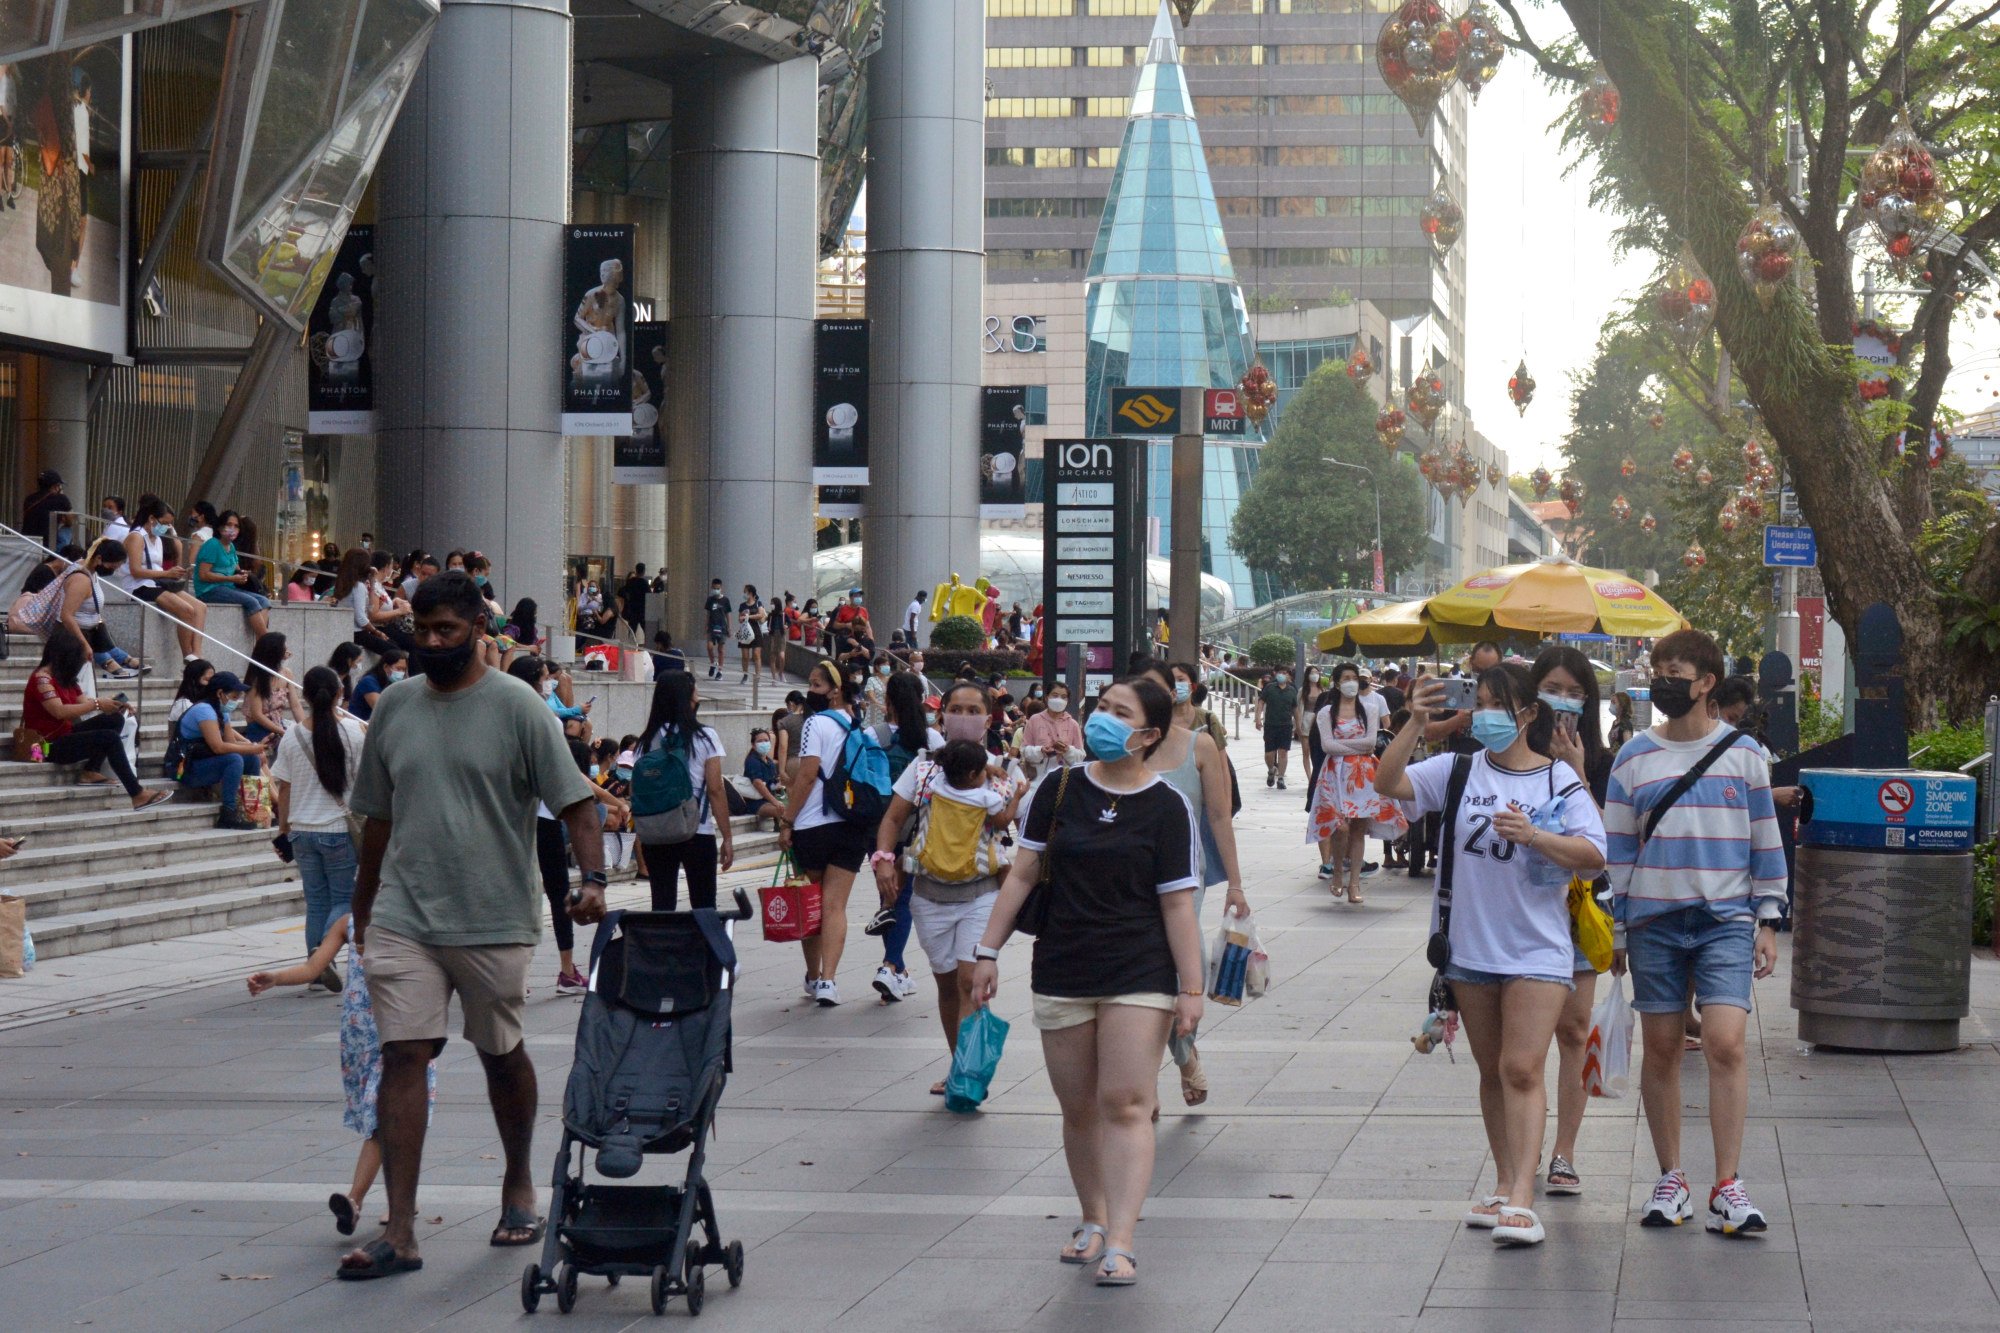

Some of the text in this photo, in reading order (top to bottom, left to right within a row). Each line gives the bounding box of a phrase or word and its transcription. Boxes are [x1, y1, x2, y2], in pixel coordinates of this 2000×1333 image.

[1211, 419, 1239, 430] MRT
[1770, 529, 1811, 540] Please Use
[1771, 540, 1810, 551] Underpass
[1597, 584, 1642, 597] Magnolia
[1925, 780, 1942, 790] NO
[1925, 791, 1967, 801] SMOKING
[1925, 802, 1952, 812] ZONE
